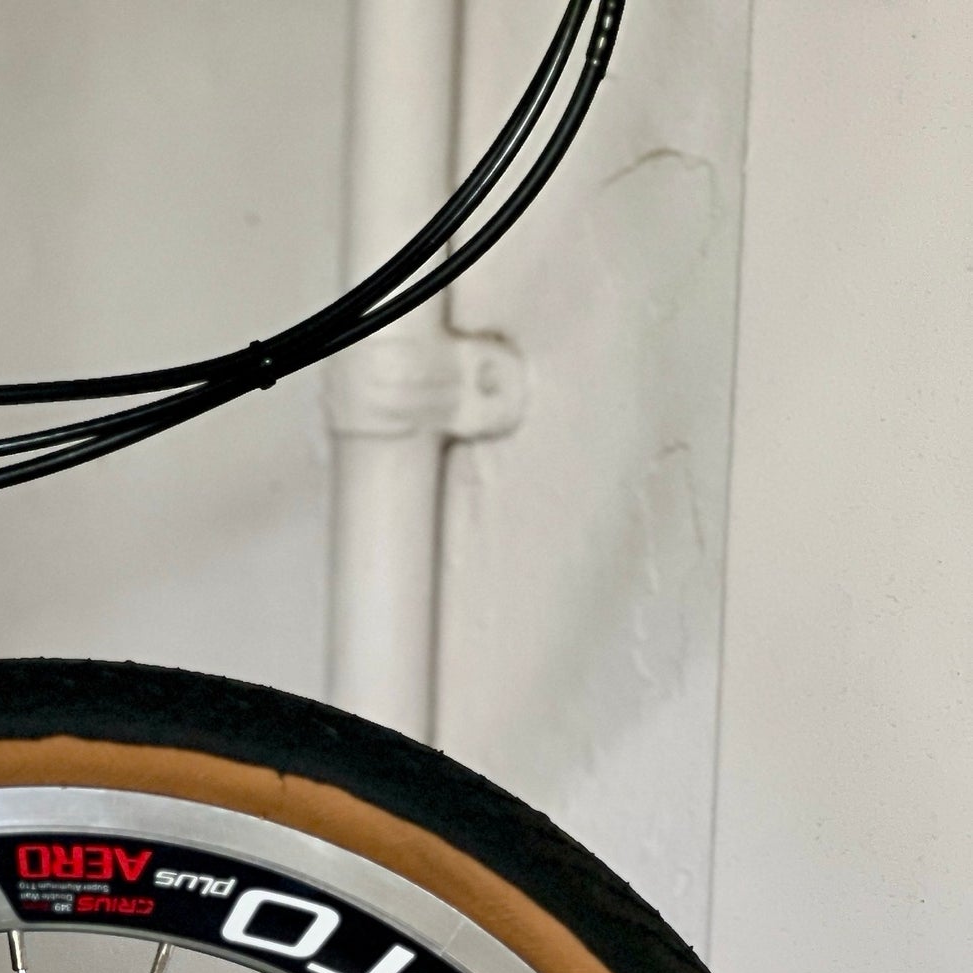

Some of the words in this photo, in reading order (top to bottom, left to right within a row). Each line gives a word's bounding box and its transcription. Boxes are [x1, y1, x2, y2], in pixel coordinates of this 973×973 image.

[16, 844, 153, 882] AERO
[42, 893, 73, 902] Double
[53, 902, 73, 912] 349
[77, 896, 155, 916] CRIUS
